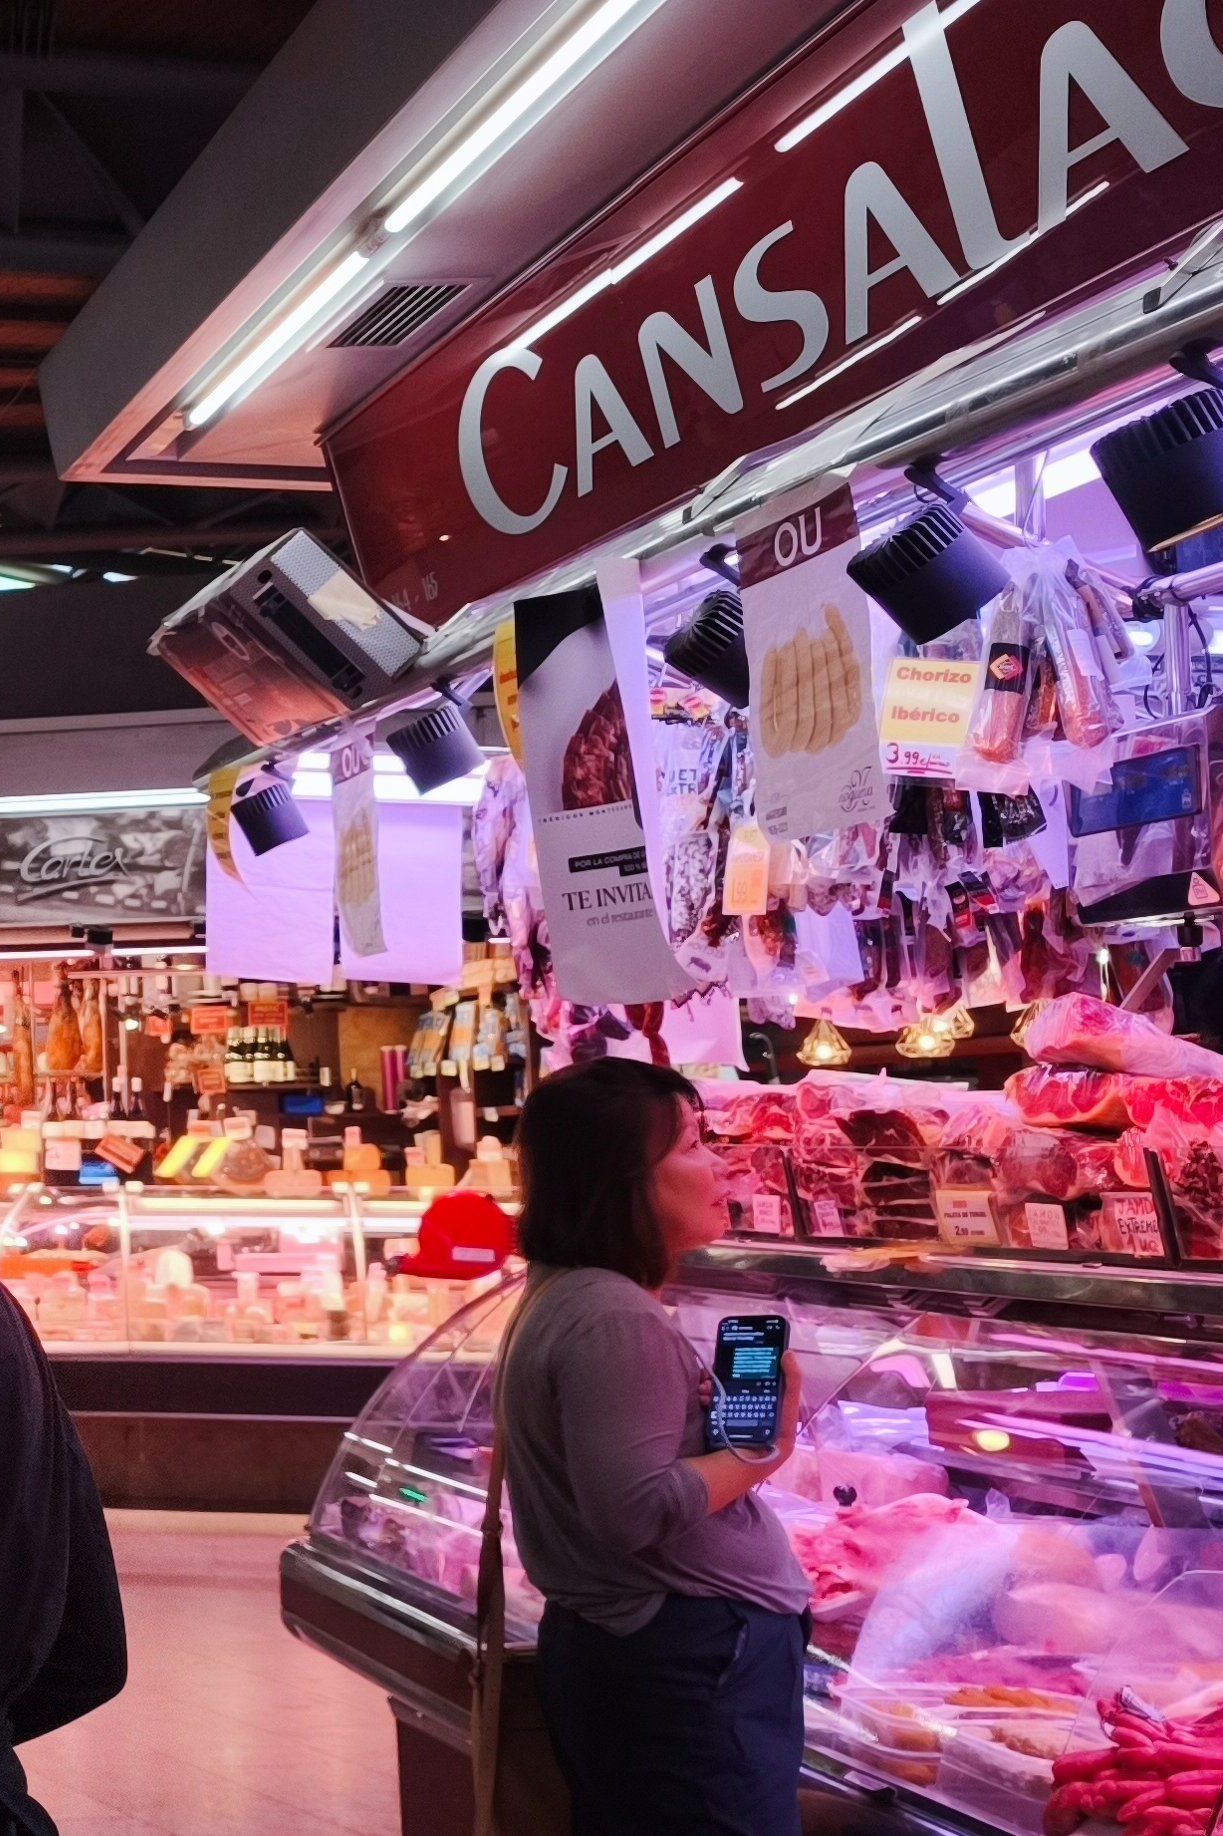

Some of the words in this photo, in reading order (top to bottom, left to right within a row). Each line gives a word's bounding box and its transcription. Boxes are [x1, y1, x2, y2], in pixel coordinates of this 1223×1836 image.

[775, 507, 821, 567] OU
[897, 667, 973, 684] Chorizo
[891, 706, 960, 723] Ibérico
[562, 890, 593, 911] TE
